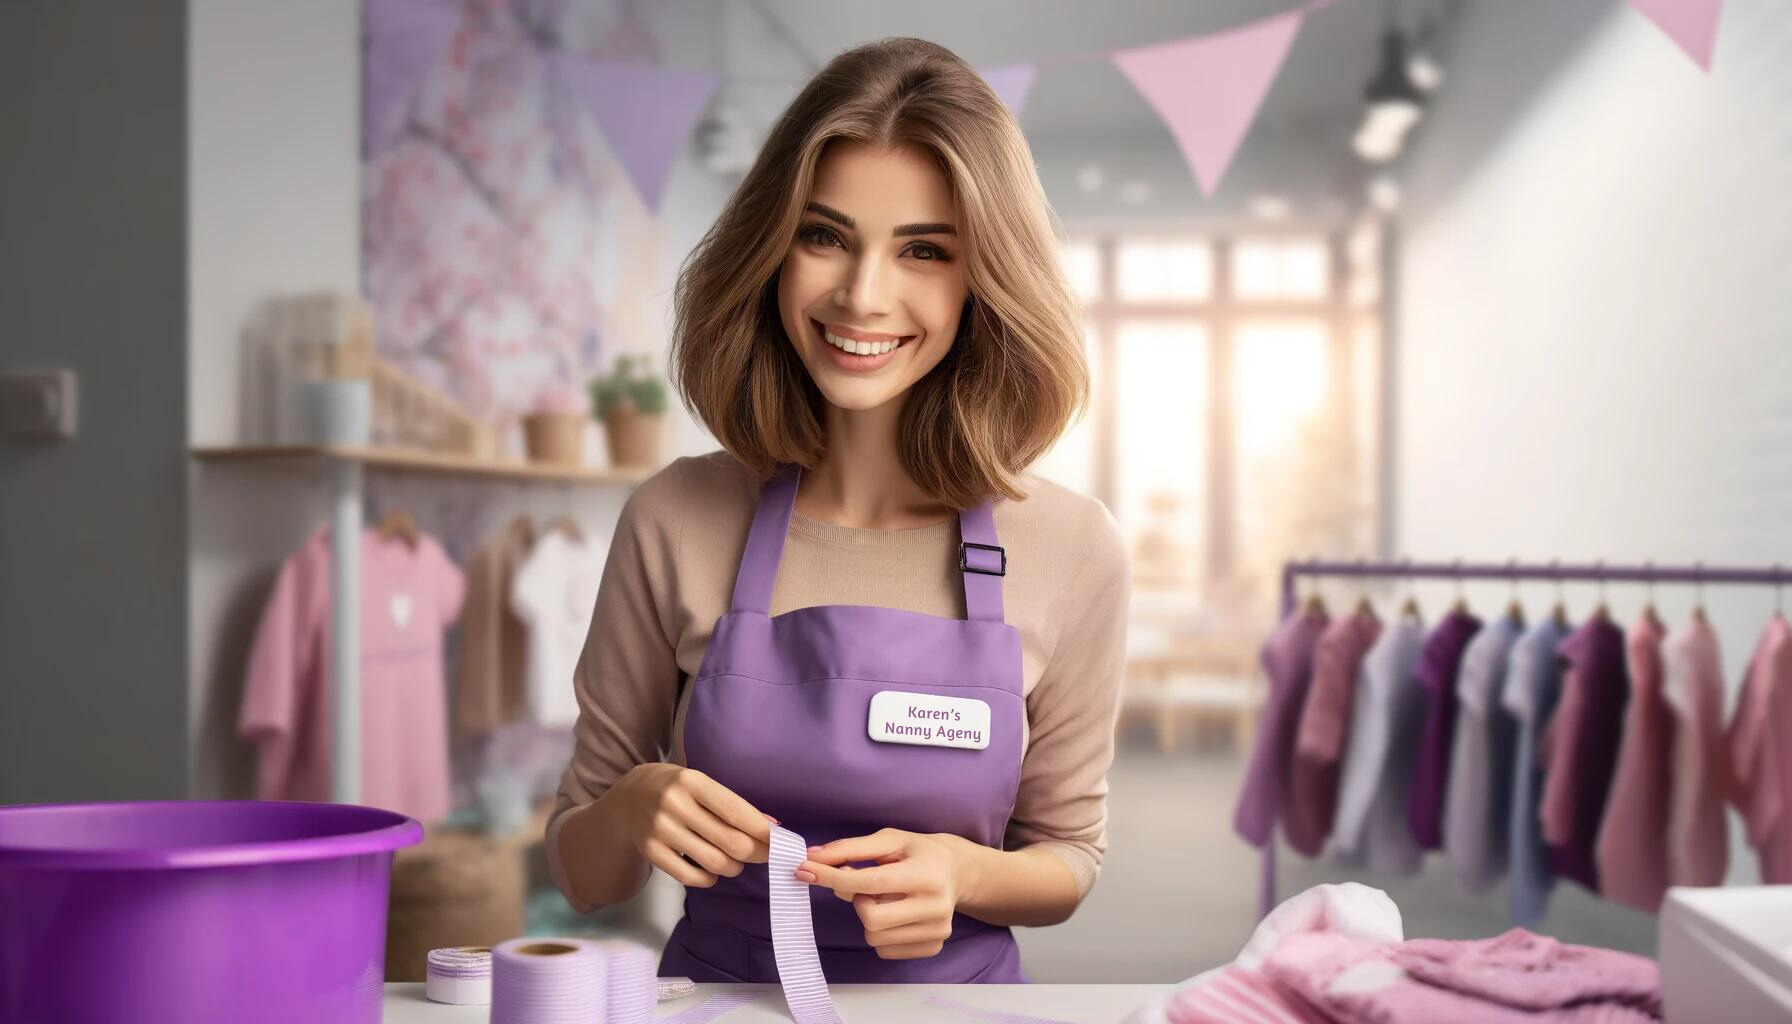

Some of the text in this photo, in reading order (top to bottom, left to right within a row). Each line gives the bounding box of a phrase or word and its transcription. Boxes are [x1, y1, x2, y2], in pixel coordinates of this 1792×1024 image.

[908, 706, 961, 721] Karen’s
[885, 722, 981, 743] Nanny Ageny
